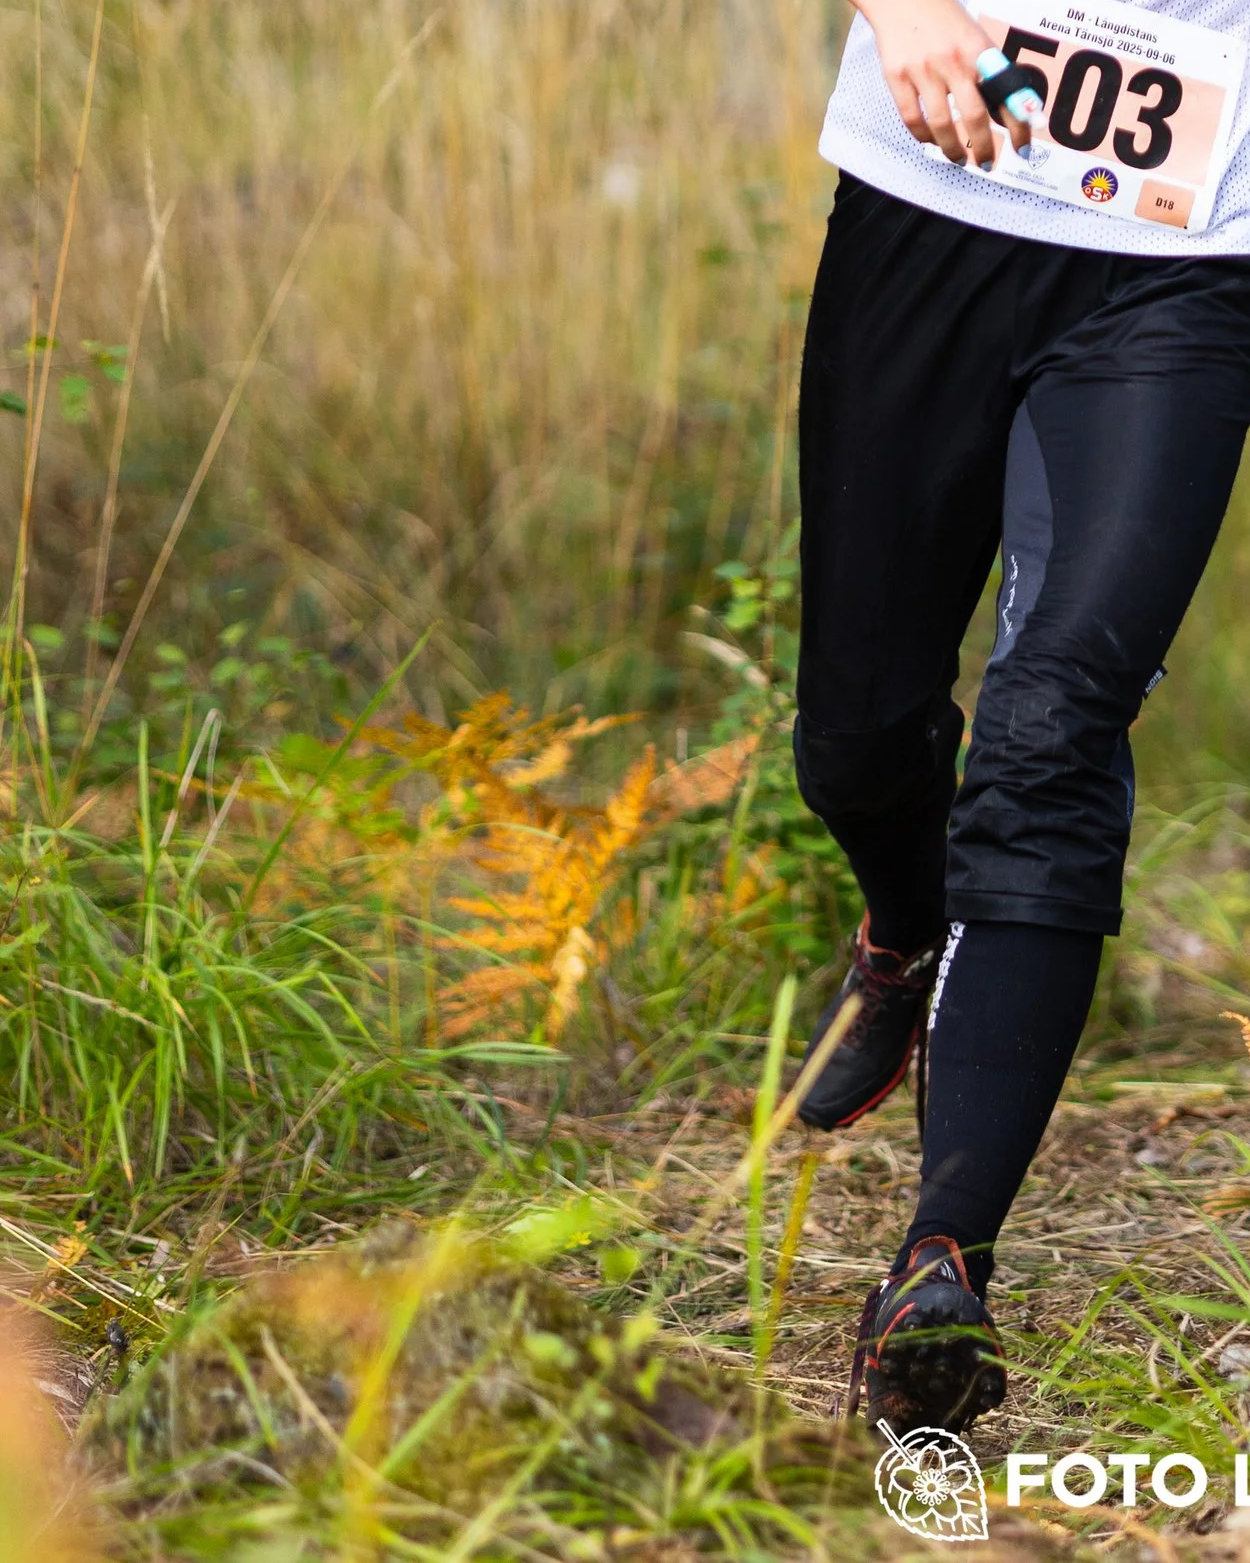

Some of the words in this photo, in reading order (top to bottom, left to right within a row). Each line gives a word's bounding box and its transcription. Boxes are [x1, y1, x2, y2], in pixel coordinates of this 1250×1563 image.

[1066, 8, 1085, 22] DM
[1039, 17, 1071, 35] Arena
[1075, 27, 1114, 48] Tärnsjö
[1116, 40, 1175, 65] 2025-09-06
[1155, 196, 1175, 211] D18
